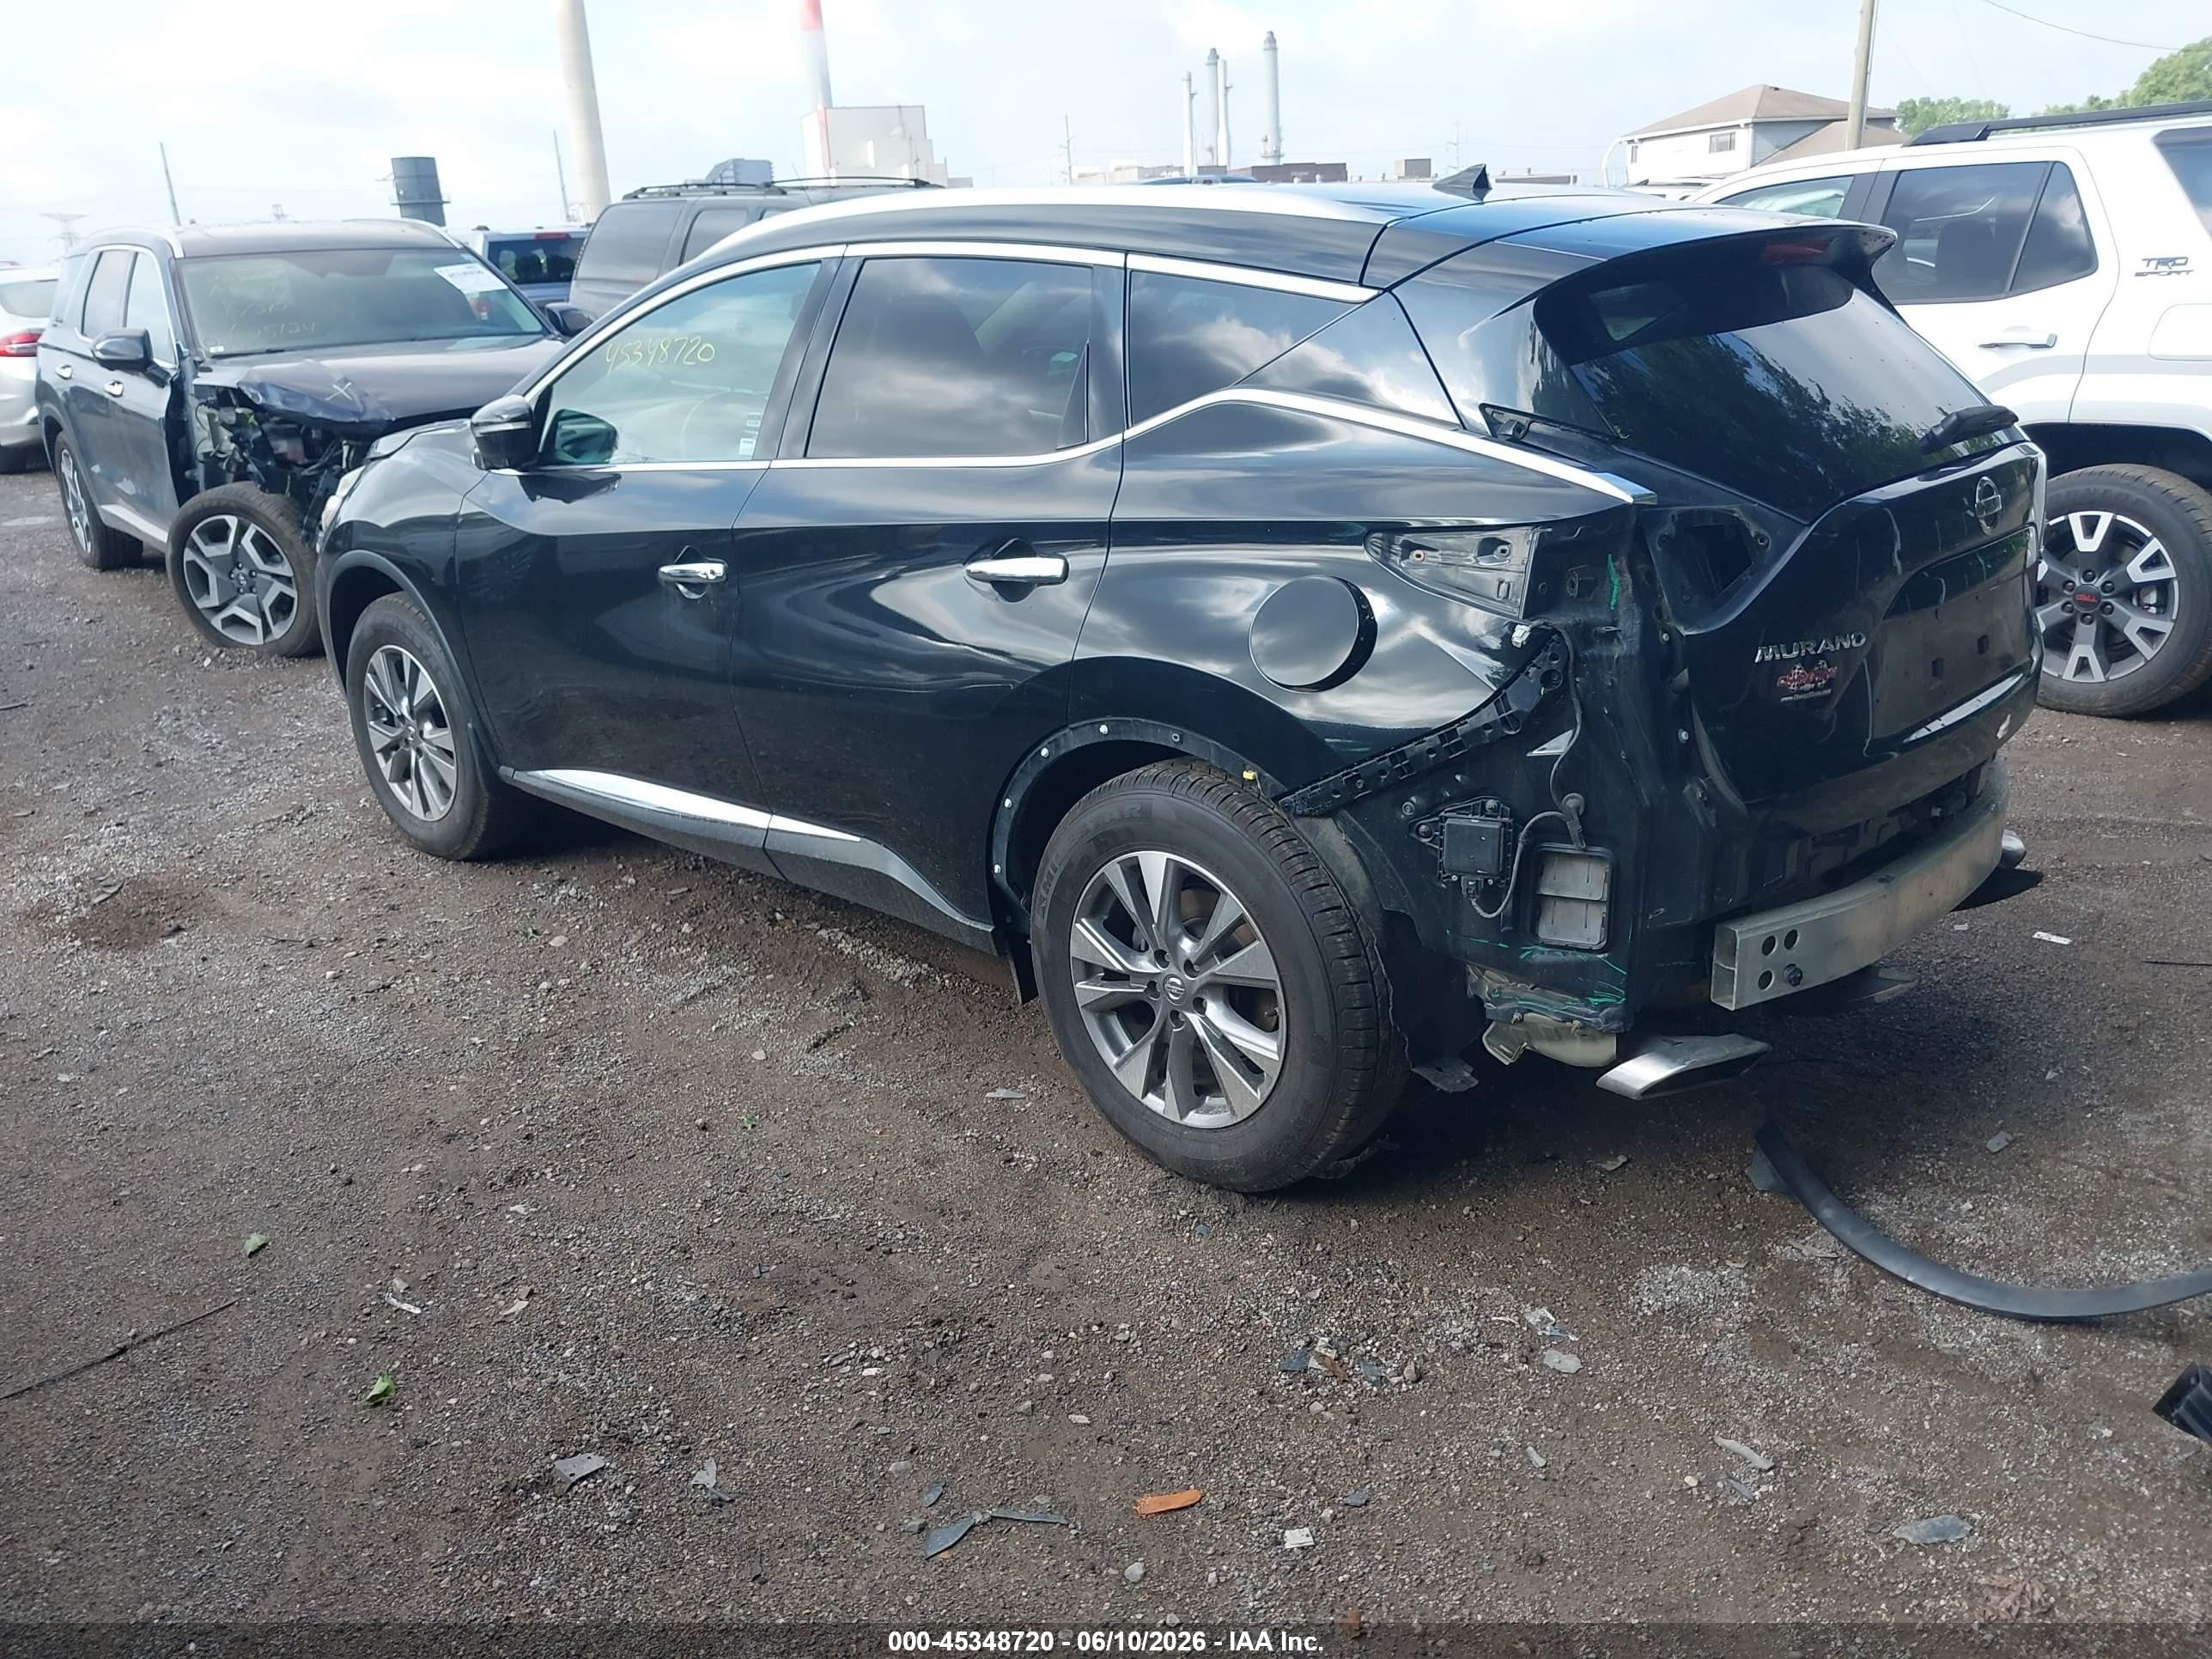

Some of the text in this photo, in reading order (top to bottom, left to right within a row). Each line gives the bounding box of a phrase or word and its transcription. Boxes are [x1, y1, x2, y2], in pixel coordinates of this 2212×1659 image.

[2142, 256, 2189, 270] TRD
[605, 335, 715, 376] 45348720
[1753, 631, 1868, 664] MURANO
